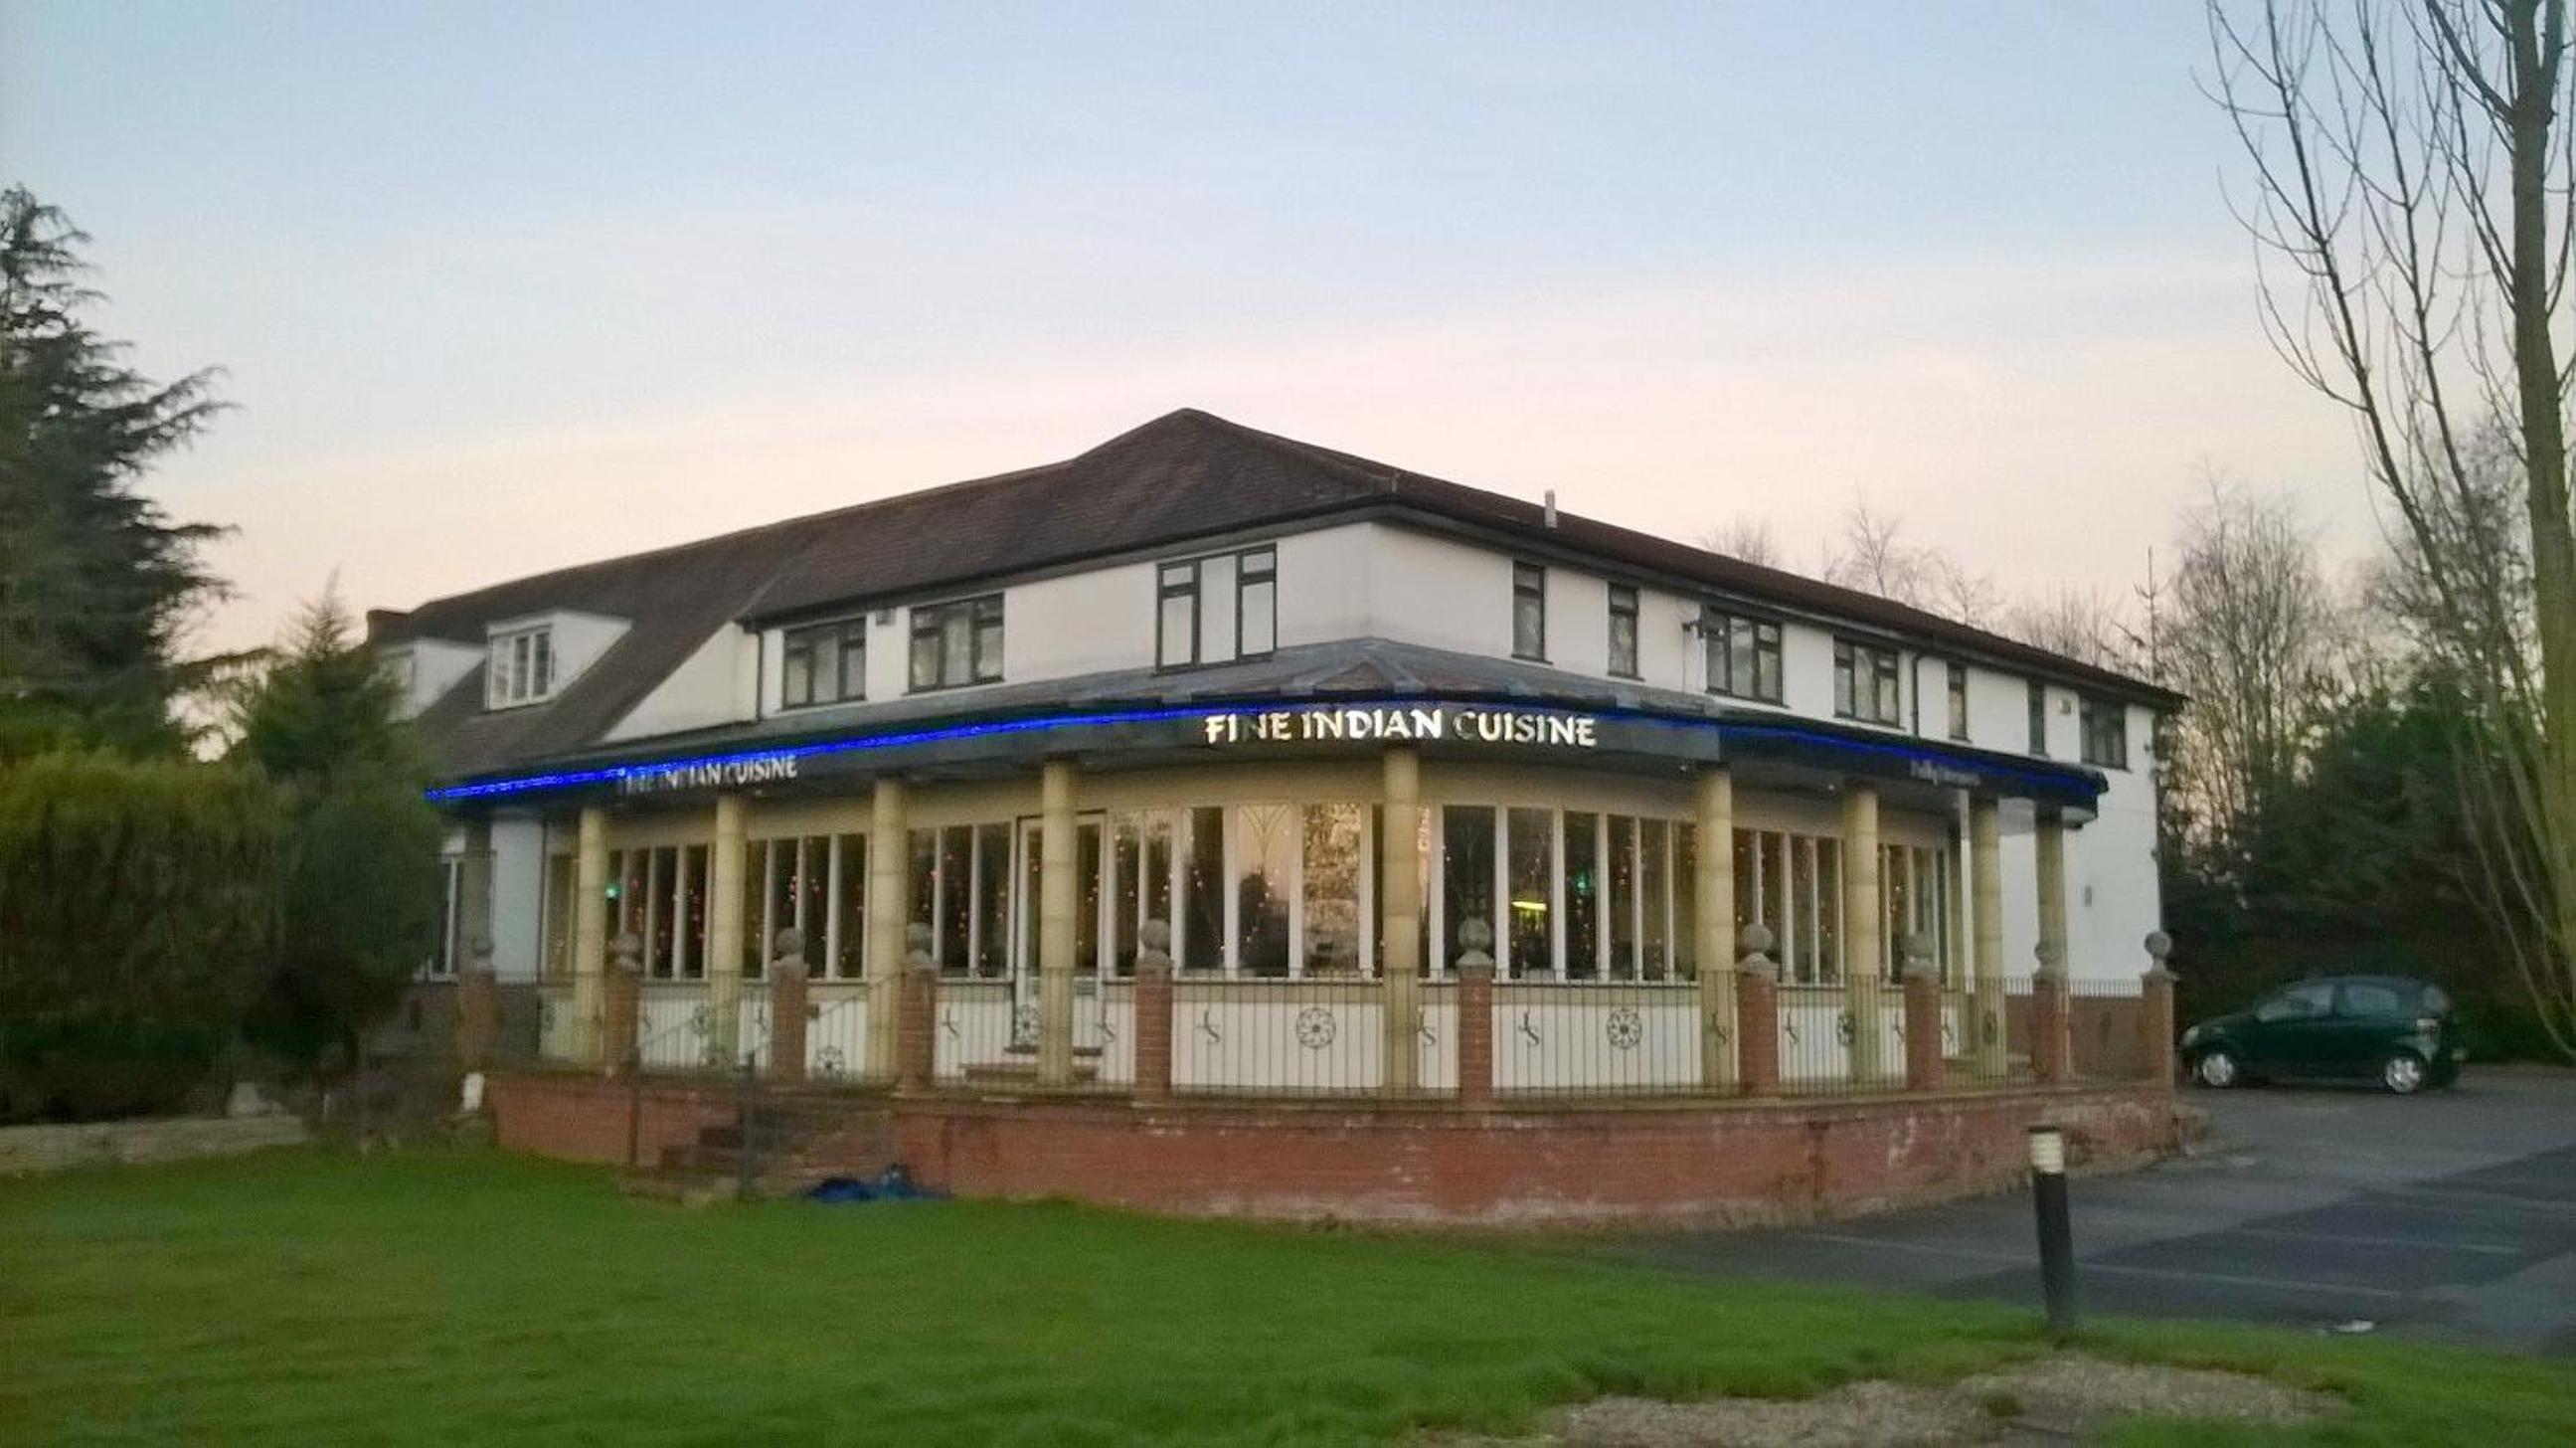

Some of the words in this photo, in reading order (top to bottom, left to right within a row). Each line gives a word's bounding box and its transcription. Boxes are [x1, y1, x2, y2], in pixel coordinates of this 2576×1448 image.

[1204, 711, 1292, 743] FINE
[1302, 708, 1443, 741] INDIAN
[1453, 710, 1599, 747] CUISINE
[725, 754, 797, 785] CUISINE
